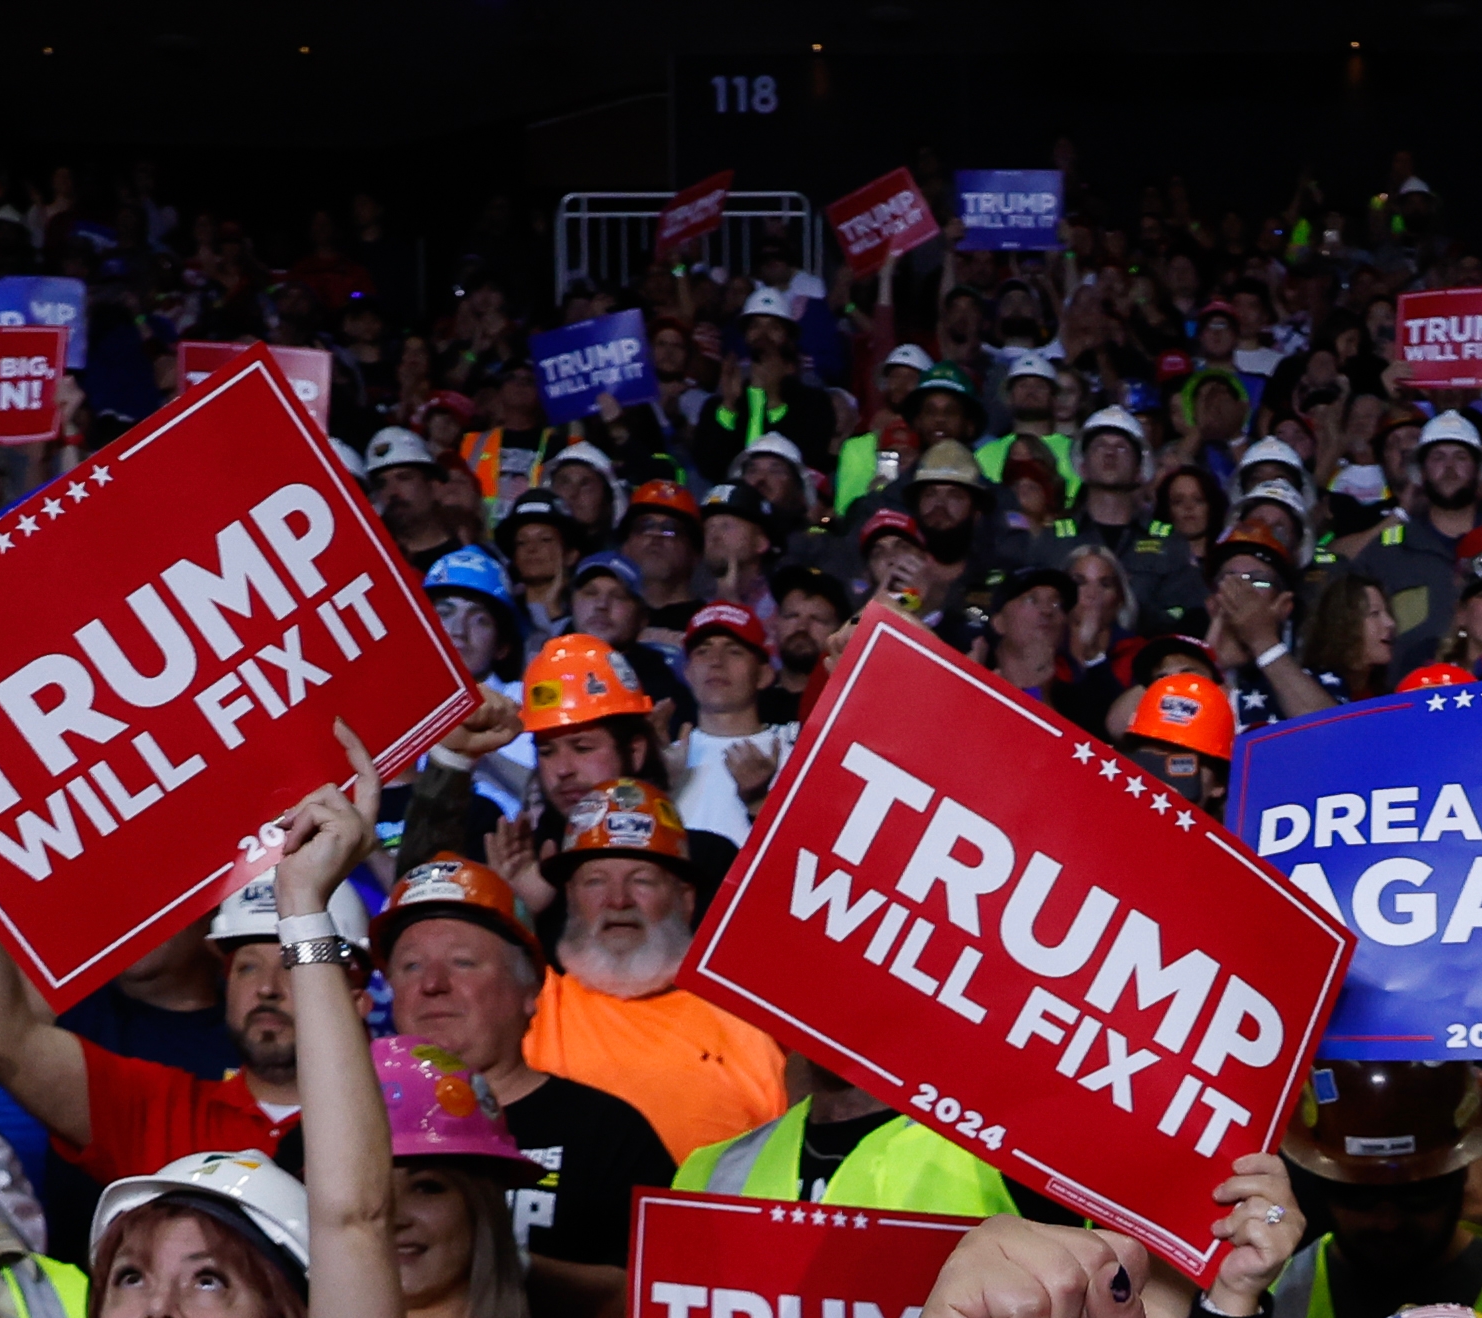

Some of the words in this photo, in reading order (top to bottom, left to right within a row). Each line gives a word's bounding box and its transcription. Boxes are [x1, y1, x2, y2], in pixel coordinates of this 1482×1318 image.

[712, 75, 778, 114] 118
[960, 192, 1058, 217] TRUMP
[1, 356, 56, 382] BIG,
[538, 337, 642, 382] TRUMP
[1404, 344, 1458, 362] WILL
[192, 641, 332, 750] FIX
[318, 573, 391, 664] IT
[831, 742, 1286, 1079] TRUMP
[789, 846, 988, 1027] WILL
[1004, 986, 1165, 1115] FIX
[1157, 1077, 1252, 1159] IT
[909, 1083, 1007, 1153] 2024
